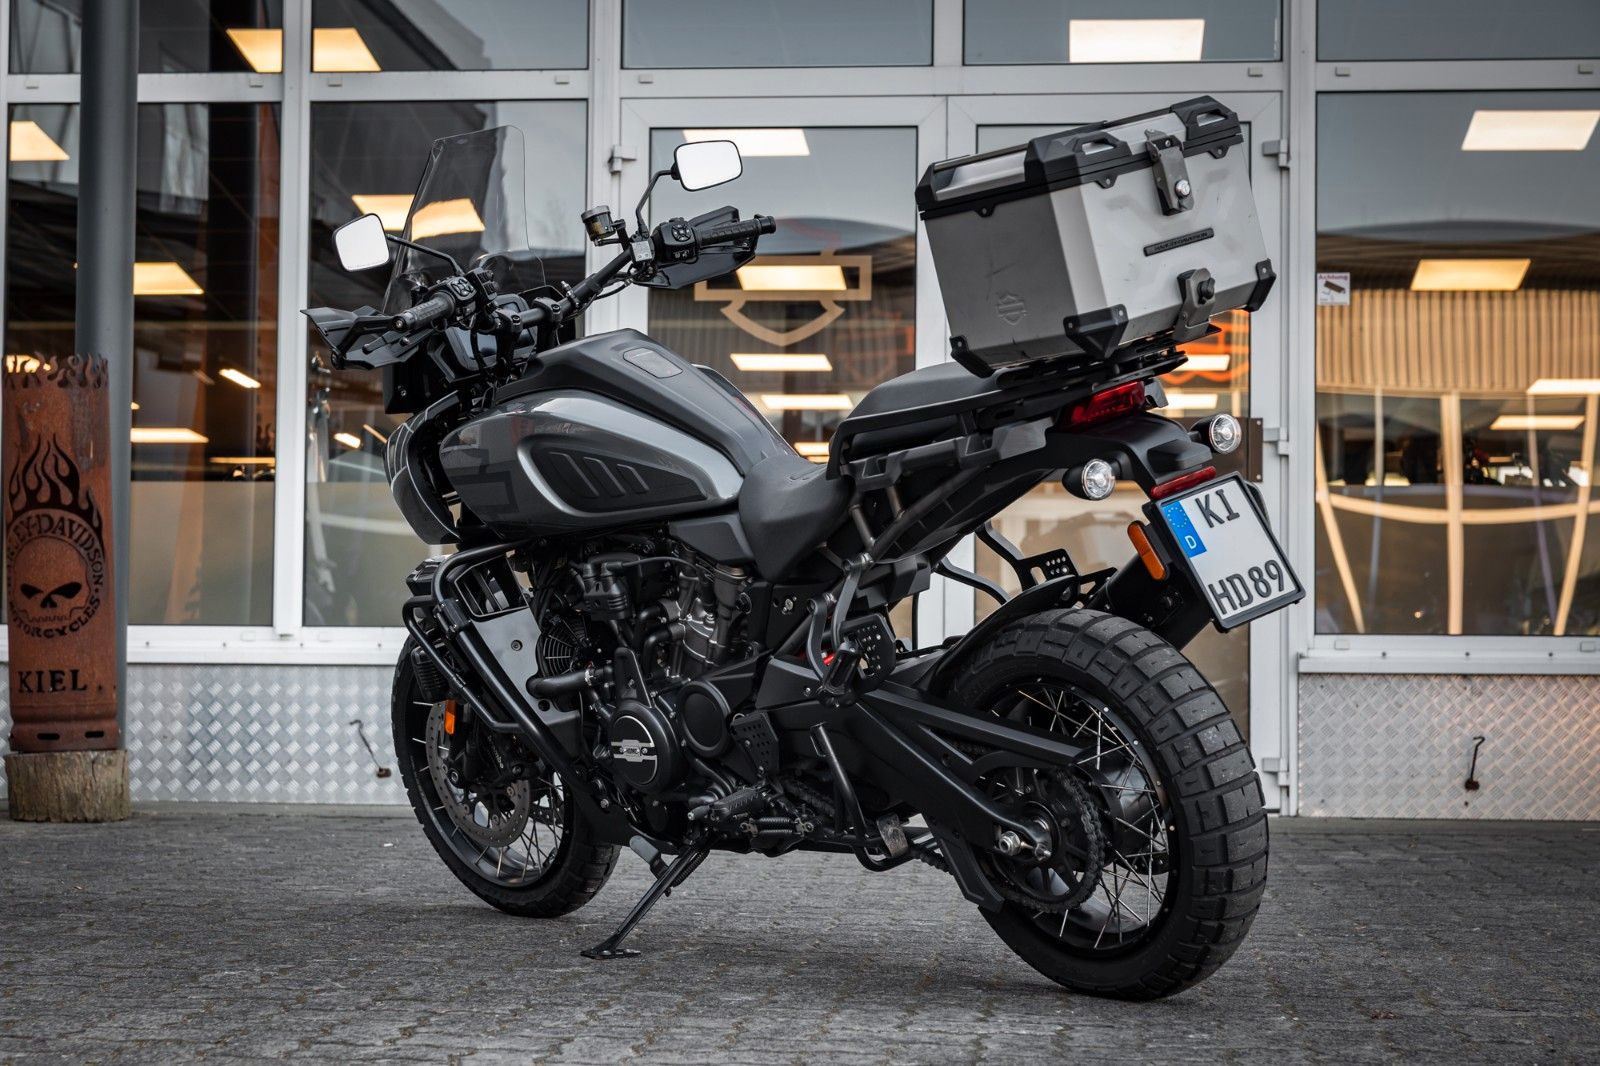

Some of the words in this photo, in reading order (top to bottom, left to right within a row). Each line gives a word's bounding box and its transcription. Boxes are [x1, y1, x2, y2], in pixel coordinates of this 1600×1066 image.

[1195, 488, 1241, 528] KI
[1184, 535, 1198, 550] D
[1208, 559, 1285, 615] HD89
[17, 669, 88, 694] KIEL
